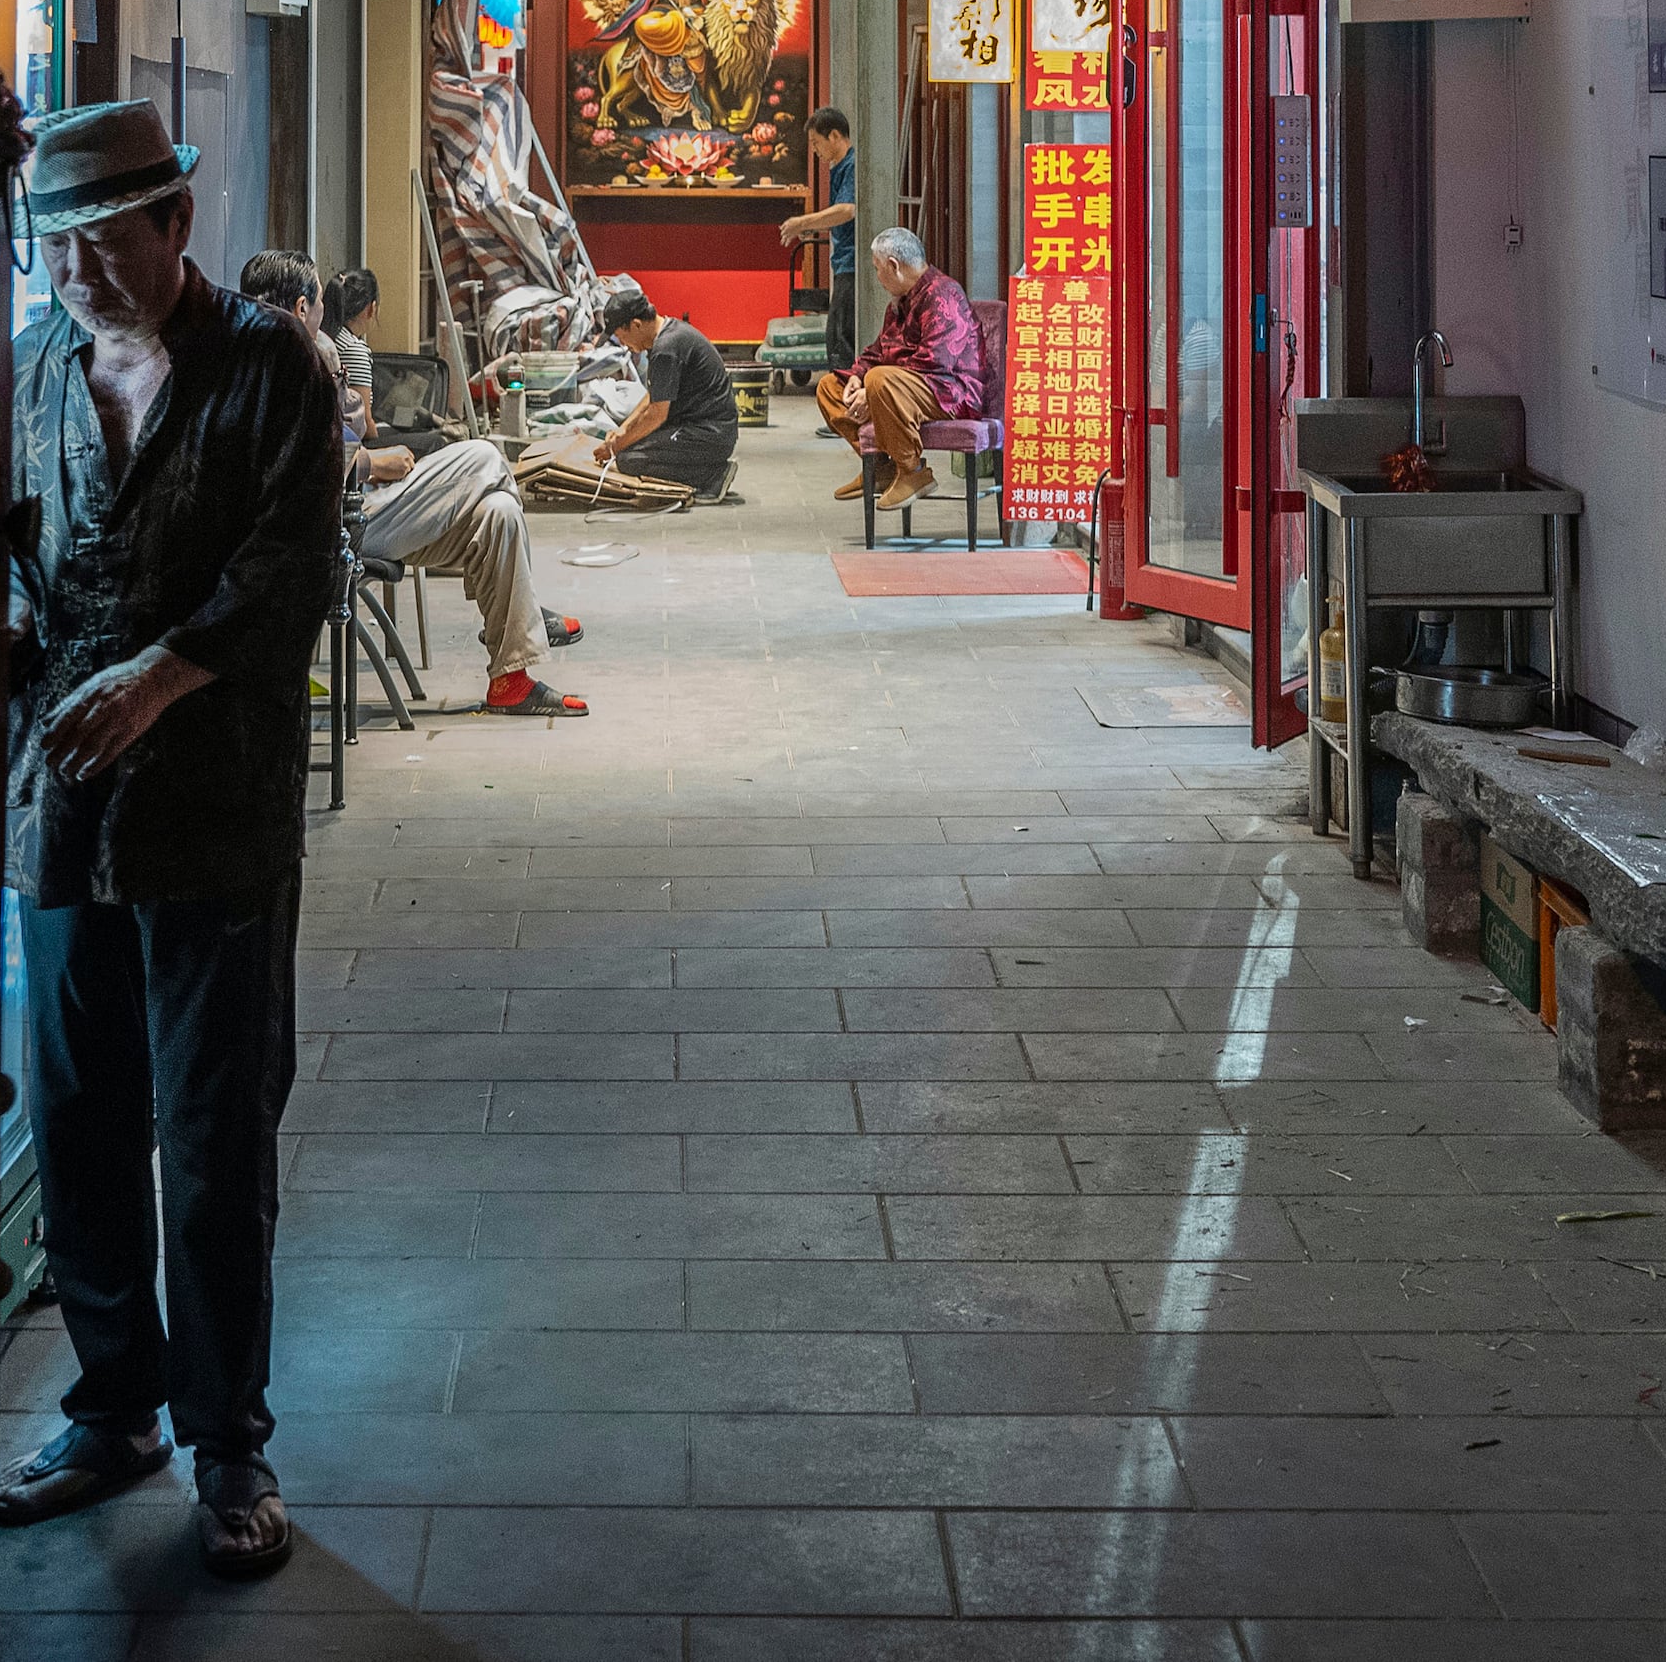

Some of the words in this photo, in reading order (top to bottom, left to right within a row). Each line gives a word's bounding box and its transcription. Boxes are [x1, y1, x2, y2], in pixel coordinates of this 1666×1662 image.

[1015, 303, 1111, 324] 起名改
[1014, 326, 1111, 348] 官运财
[1013, 348, 1111, 370] 手相面
[1013, 371, 1111, 394] 房地风
[1012, 394, 1111, 416] 择日选
[1011, 416, 1111, 440] 事业婚
[1011, 441, 1111, 463] 疑难杂
[1011, 463, 1111, 486] 消灾免
[1008, 506, 1039, 521] 136
